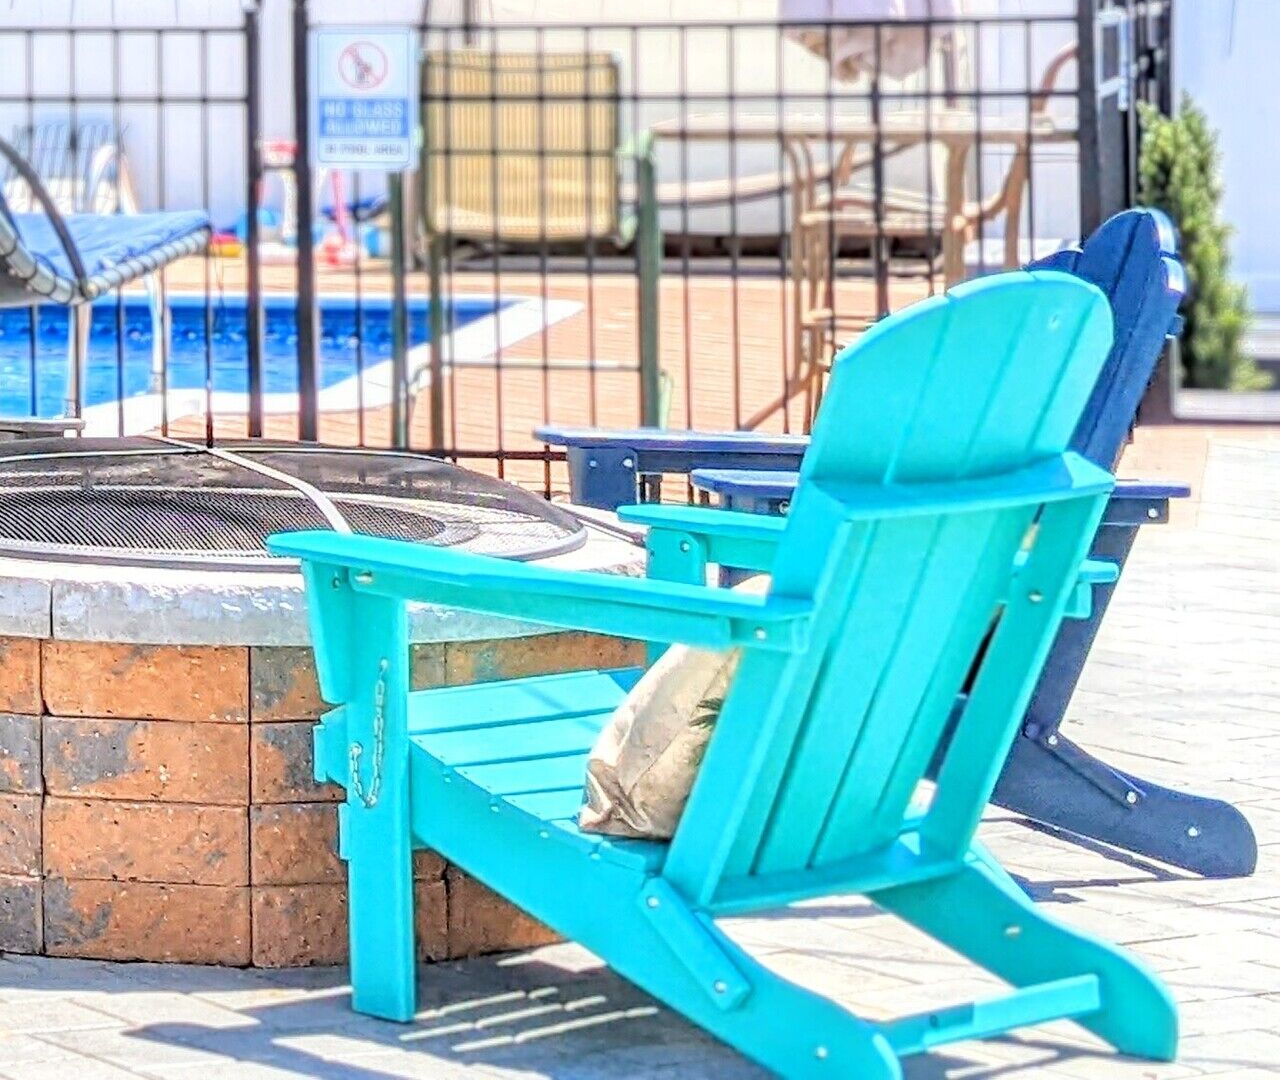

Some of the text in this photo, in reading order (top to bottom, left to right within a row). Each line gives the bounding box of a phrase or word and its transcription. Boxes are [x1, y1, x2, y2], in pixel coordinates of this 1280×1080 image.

[324, 102, 404, 118] NO GLASS
[326, 119, 403, 136] ALLOWED
